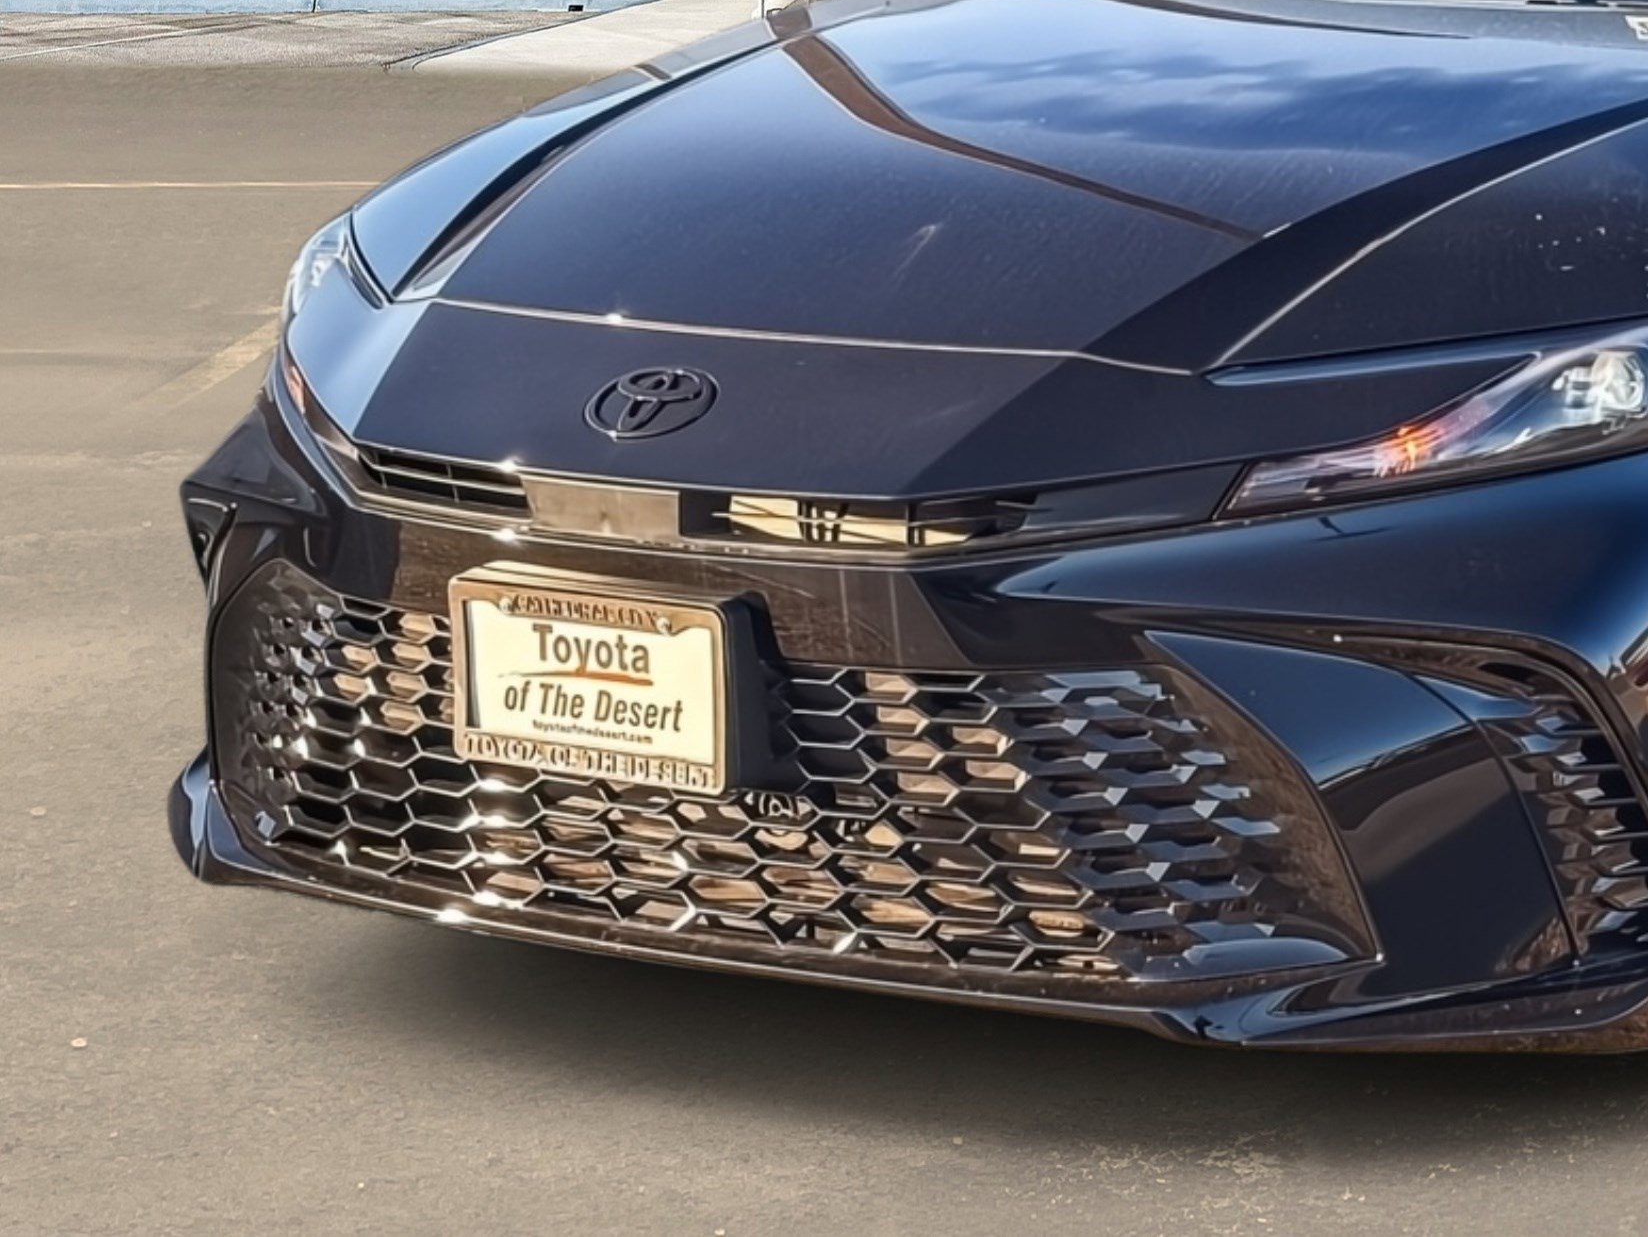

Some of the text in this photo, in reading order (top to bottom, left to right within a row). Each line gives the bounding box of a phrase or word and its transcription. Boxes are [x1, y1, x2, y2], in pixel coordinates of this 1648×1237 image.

[532, 623, 650, 674] Toyota
[504, 680, 683, 733] of The Desert
